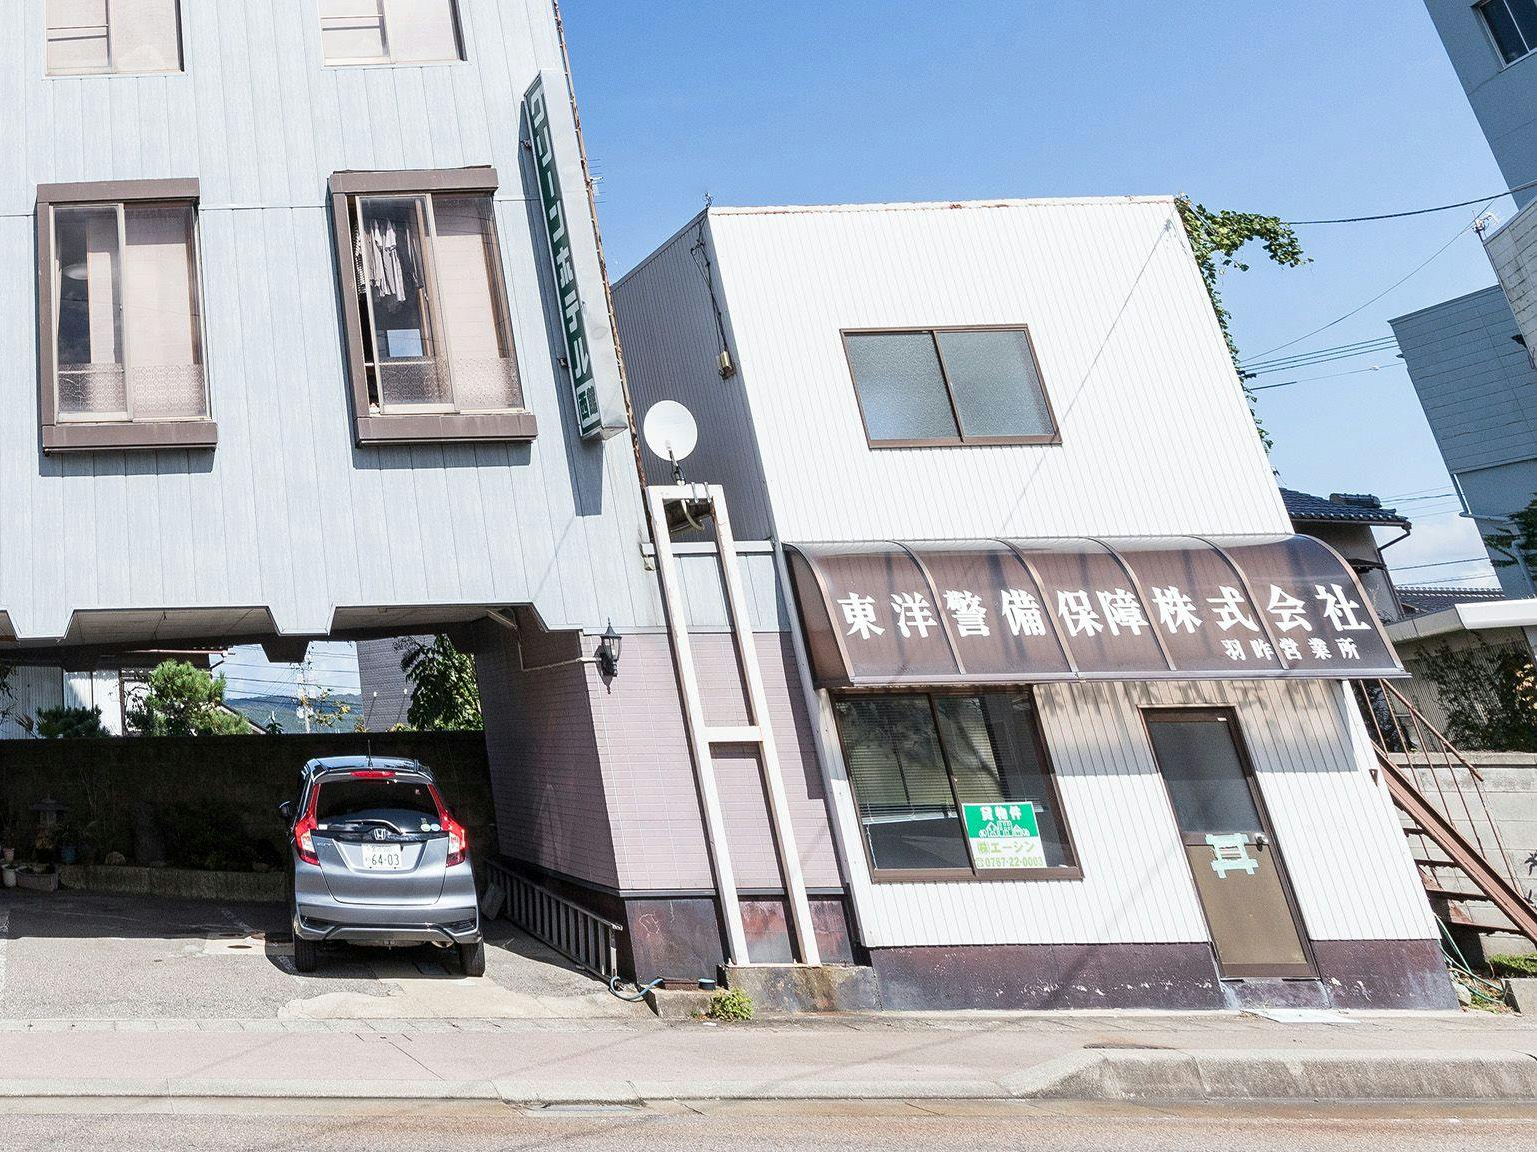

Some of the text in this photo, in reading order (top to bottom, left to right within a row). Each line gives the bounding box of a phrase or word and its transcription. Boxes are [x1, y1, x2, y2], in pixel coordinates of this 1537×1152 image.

[836, 583, 1371, 640] 東洋警備保障株式会社
[1220, 637, 1360, 661] 羽咋営業所
